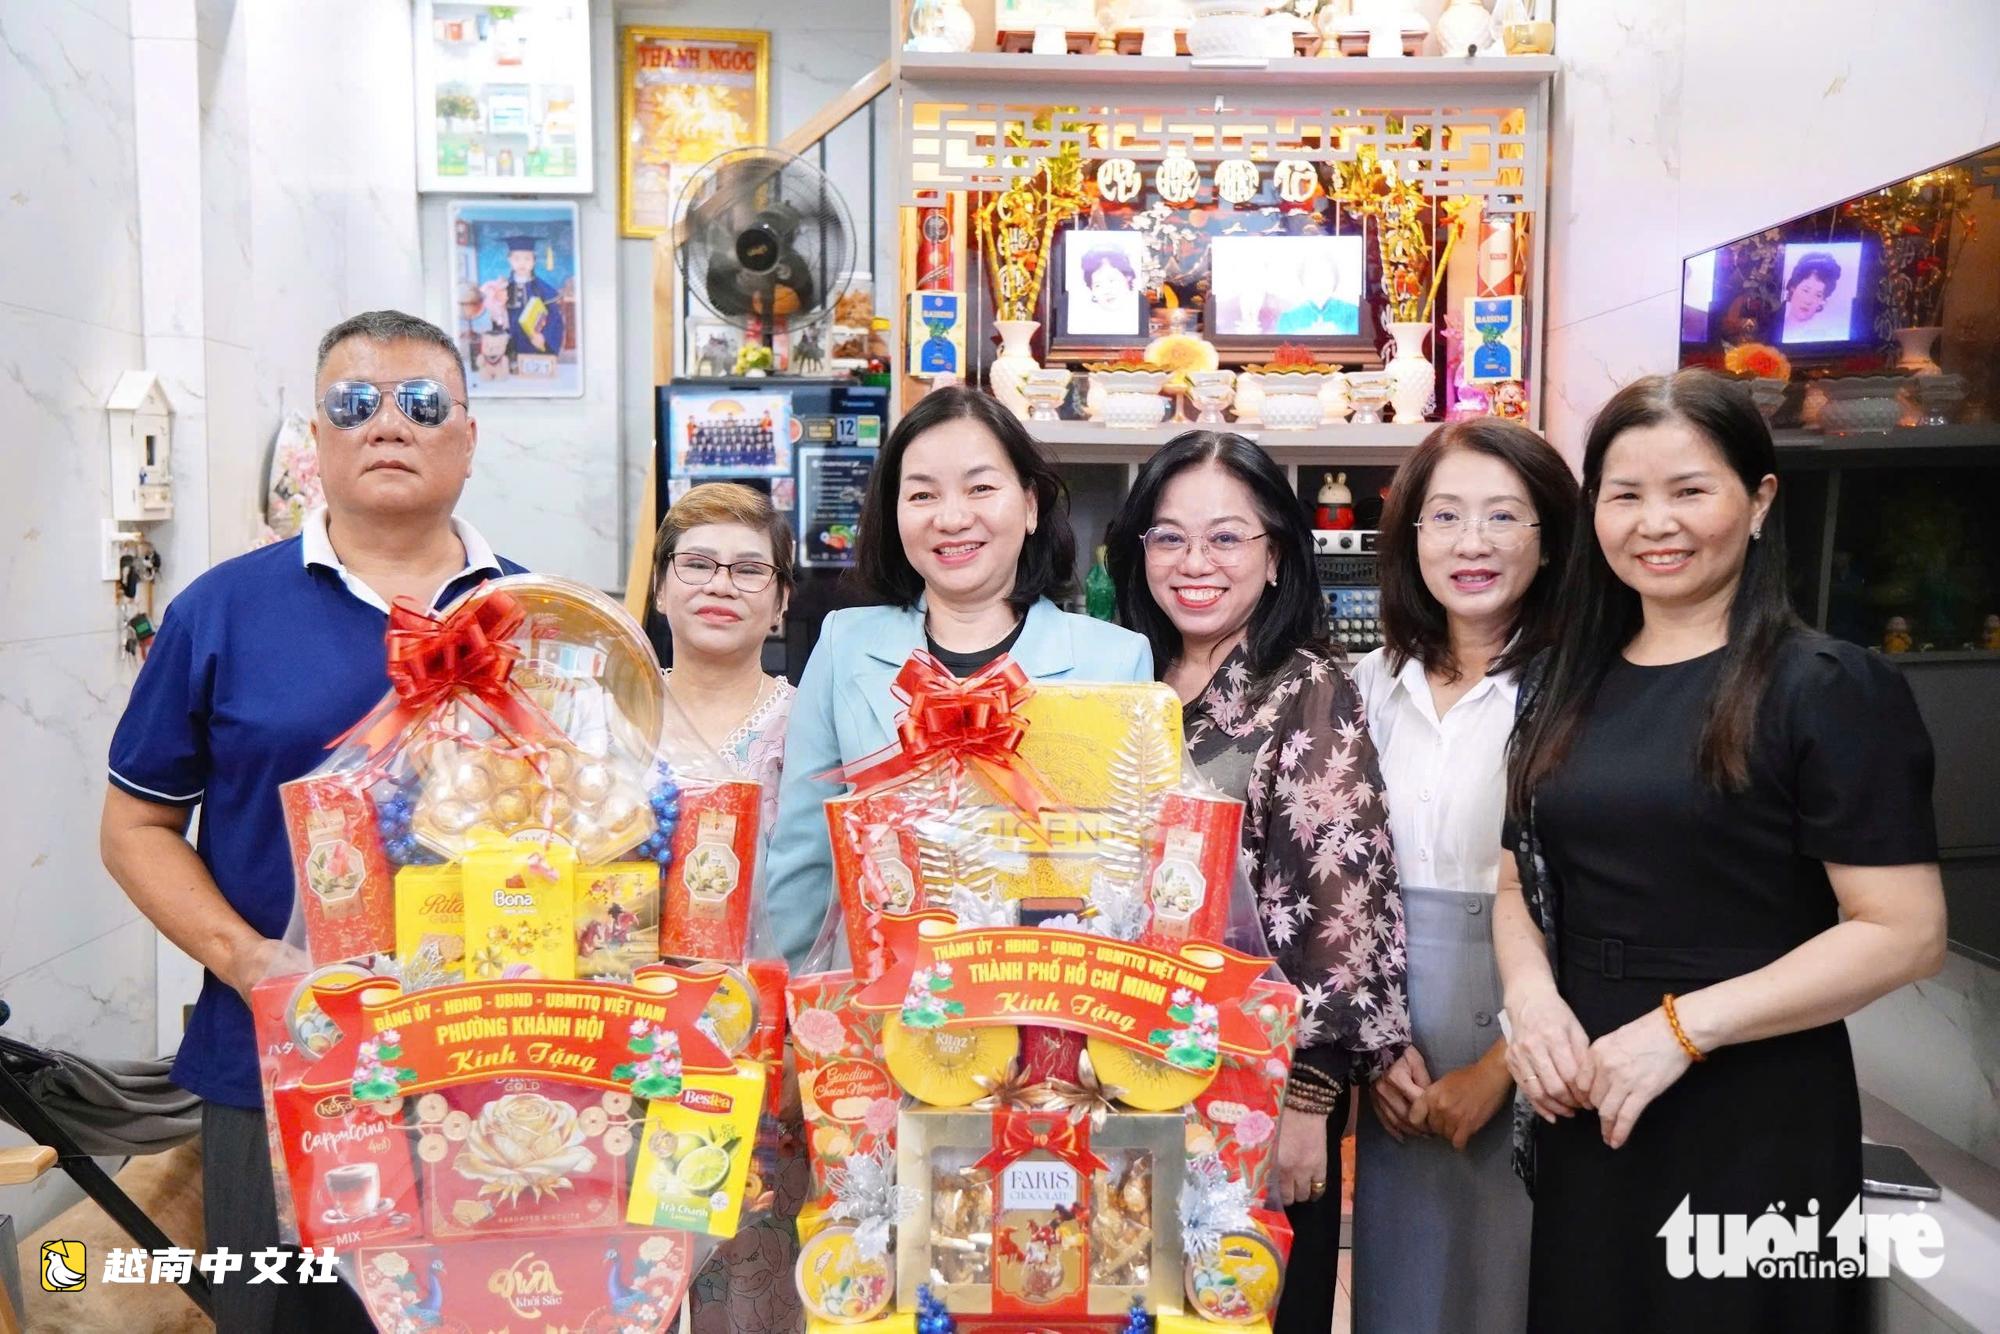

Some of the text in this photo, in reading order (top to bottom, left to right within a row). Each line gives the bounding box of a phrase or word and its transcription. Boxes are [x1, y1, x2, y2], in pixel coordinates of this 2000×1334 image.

[840, 419, 854, 436] 12
[494, 889, 533, 907] Bona
[932, 940, 975, 961] THÀNH
[976, 935, 993, 956] ỦY
[1005, 939, 1040, 954] HĐND
[1050, 940, 1086, 958] UBND
[1096, 946, 1145, 972] UBMTTQ
[1147, 957, 1174, 980] VIỆT
[1174, 969, 1207, 993] NAM
[968, 956, 1168, 1006] THÀNH PHỐ HỒ CHÍ MINH
[415, 1001, 431, 1023] ỦY
[444, 995, 482, 1015] HĐND
[495, 992, 533, 1008] UBND
[545, 993, 601, 1009] UBMTTQ
[604, 996, 632, 1016] VIỆT
[634, 1001, 667, 1022] NAM
[1070, 994, 1137, 1032] Tặng
[437, 1012, 605, 1045] PHƯỜNG KHÁNH HỘI
[527, 1042, 599, 1073] Tặng
[504, 1081, 541, 1092] GOLD
[684, 1089, 732, 1109] Bestea
[302, 1120, 385, 1154] Cappuccino
[660, 1200, 675, 1213] Trà
[678, 1203, 709, 1217] Chanh
[336, 1231, 361, 1247] MIX
